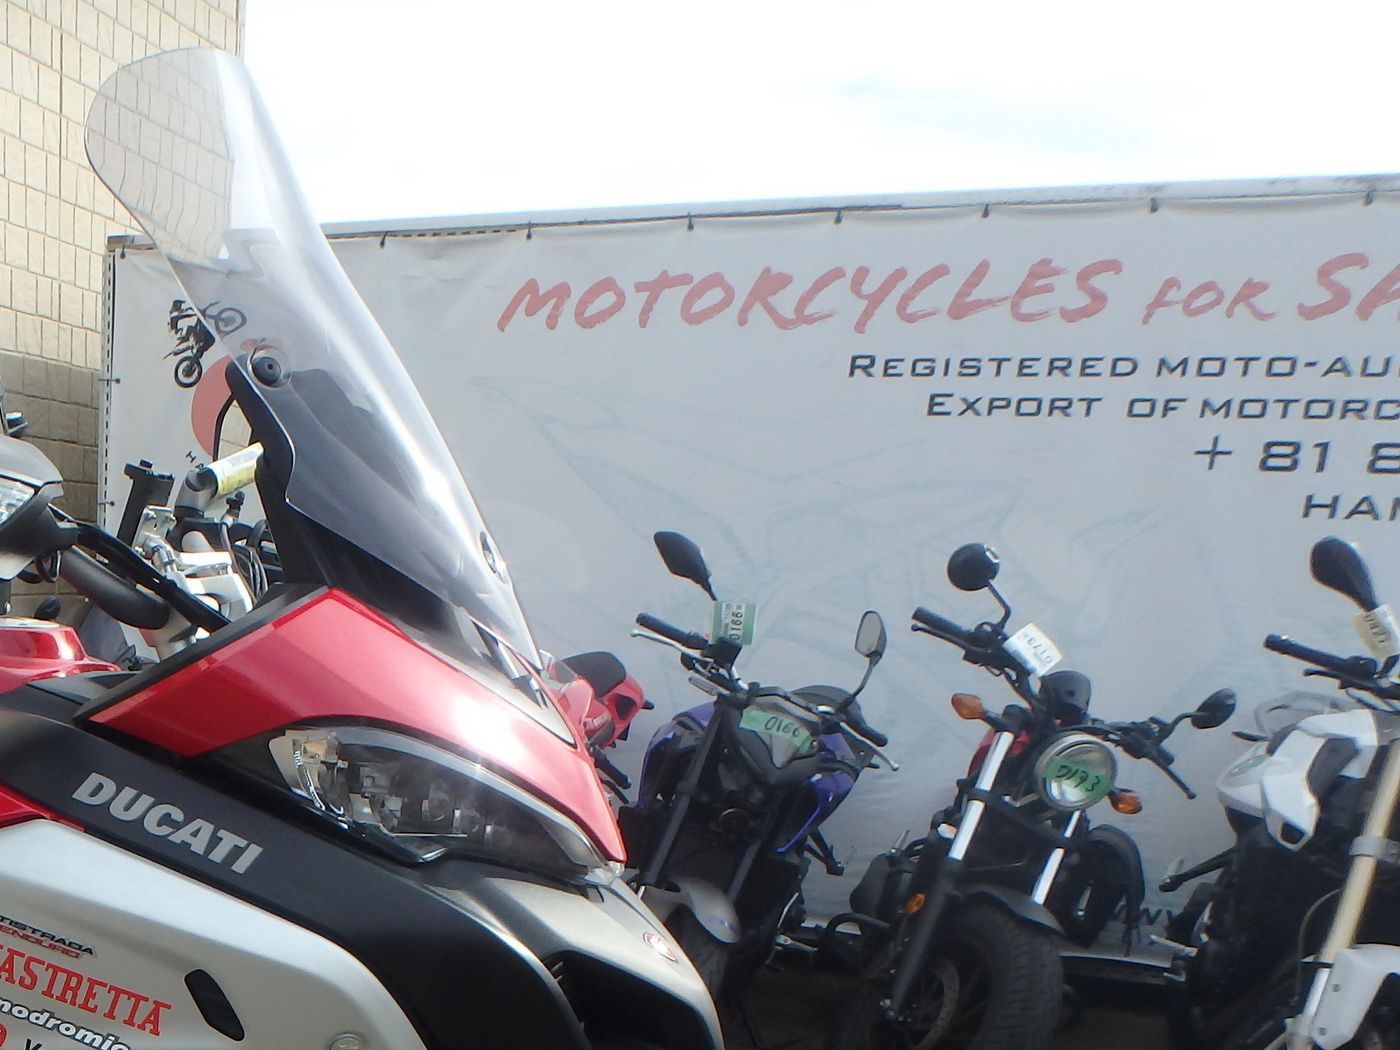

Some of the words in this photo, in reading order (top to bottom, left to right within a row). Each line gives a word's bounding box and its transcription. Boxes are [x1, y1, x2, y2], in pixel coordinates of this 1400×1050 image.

[496, 257, 1123, 334] MOTORCYCLES
[1142, 276, 1277, 326] FOR
[848, 354, 1138, 378] REGISTERED
[1155, 355, 1400, 378] MOTO-AU
[926, 392, 1103, 418] EXPORT
[1126, 397, 1188, 419] OF
[1198, 398, 1400, 421] MOTORC
[1258, 440, 1331, 474] 81
[71, 771, 264, 875] DUCATI
